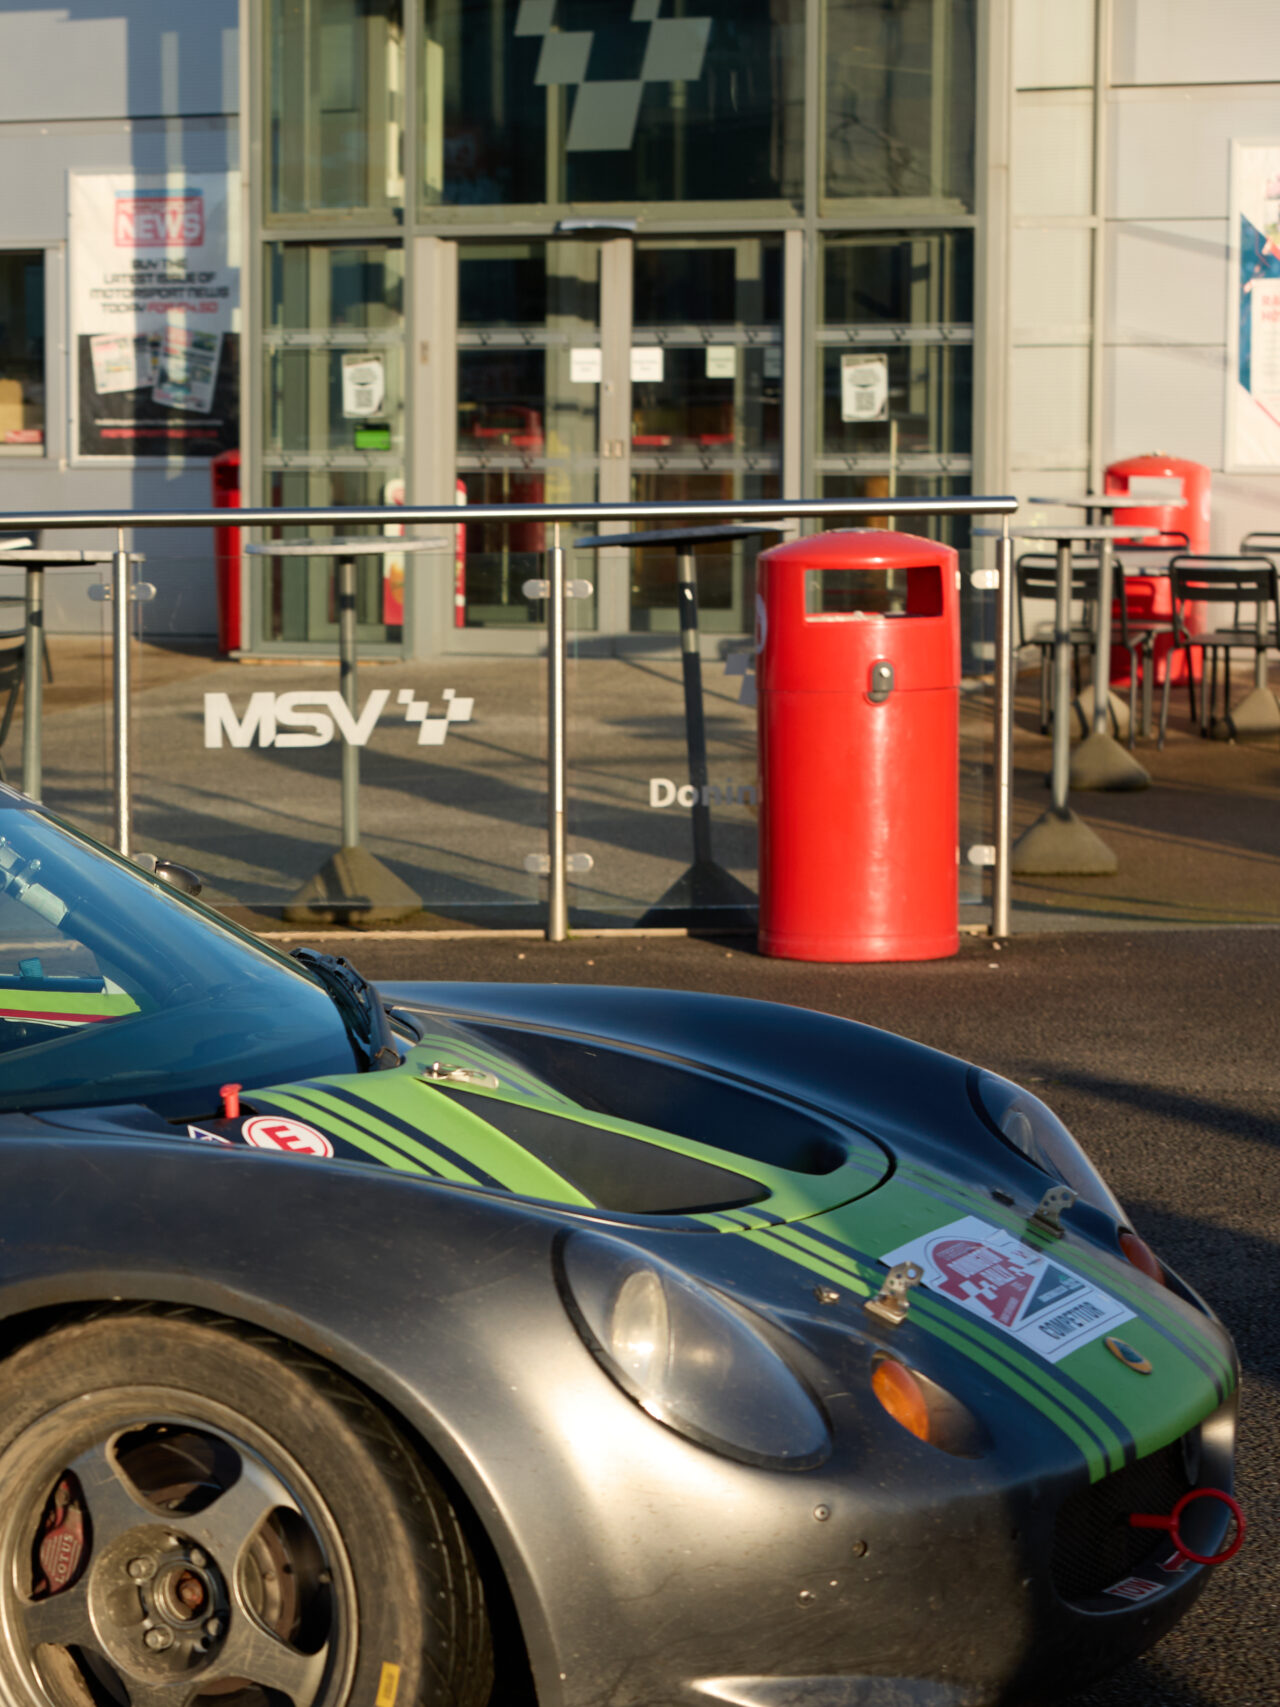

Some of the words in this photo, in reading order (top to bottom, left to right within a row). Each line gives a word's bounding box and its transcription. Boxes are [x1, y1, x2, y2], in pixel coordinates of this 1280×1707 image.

[117, 208, 201, 240] NEWS
[104, 272, 154, 285] LATEST
[198, 271, 217, 284] OF
[162, 258, 188, 270] THE
[204, 688, 391, 749] MSV
[260, 1124, 317, 1156] E
[1038, 1300, 1107, 1340] COMPETITOR
[54, 1533, 74, 1585] LOTUS
[1110, 1578, 1159, 1600] TOW
